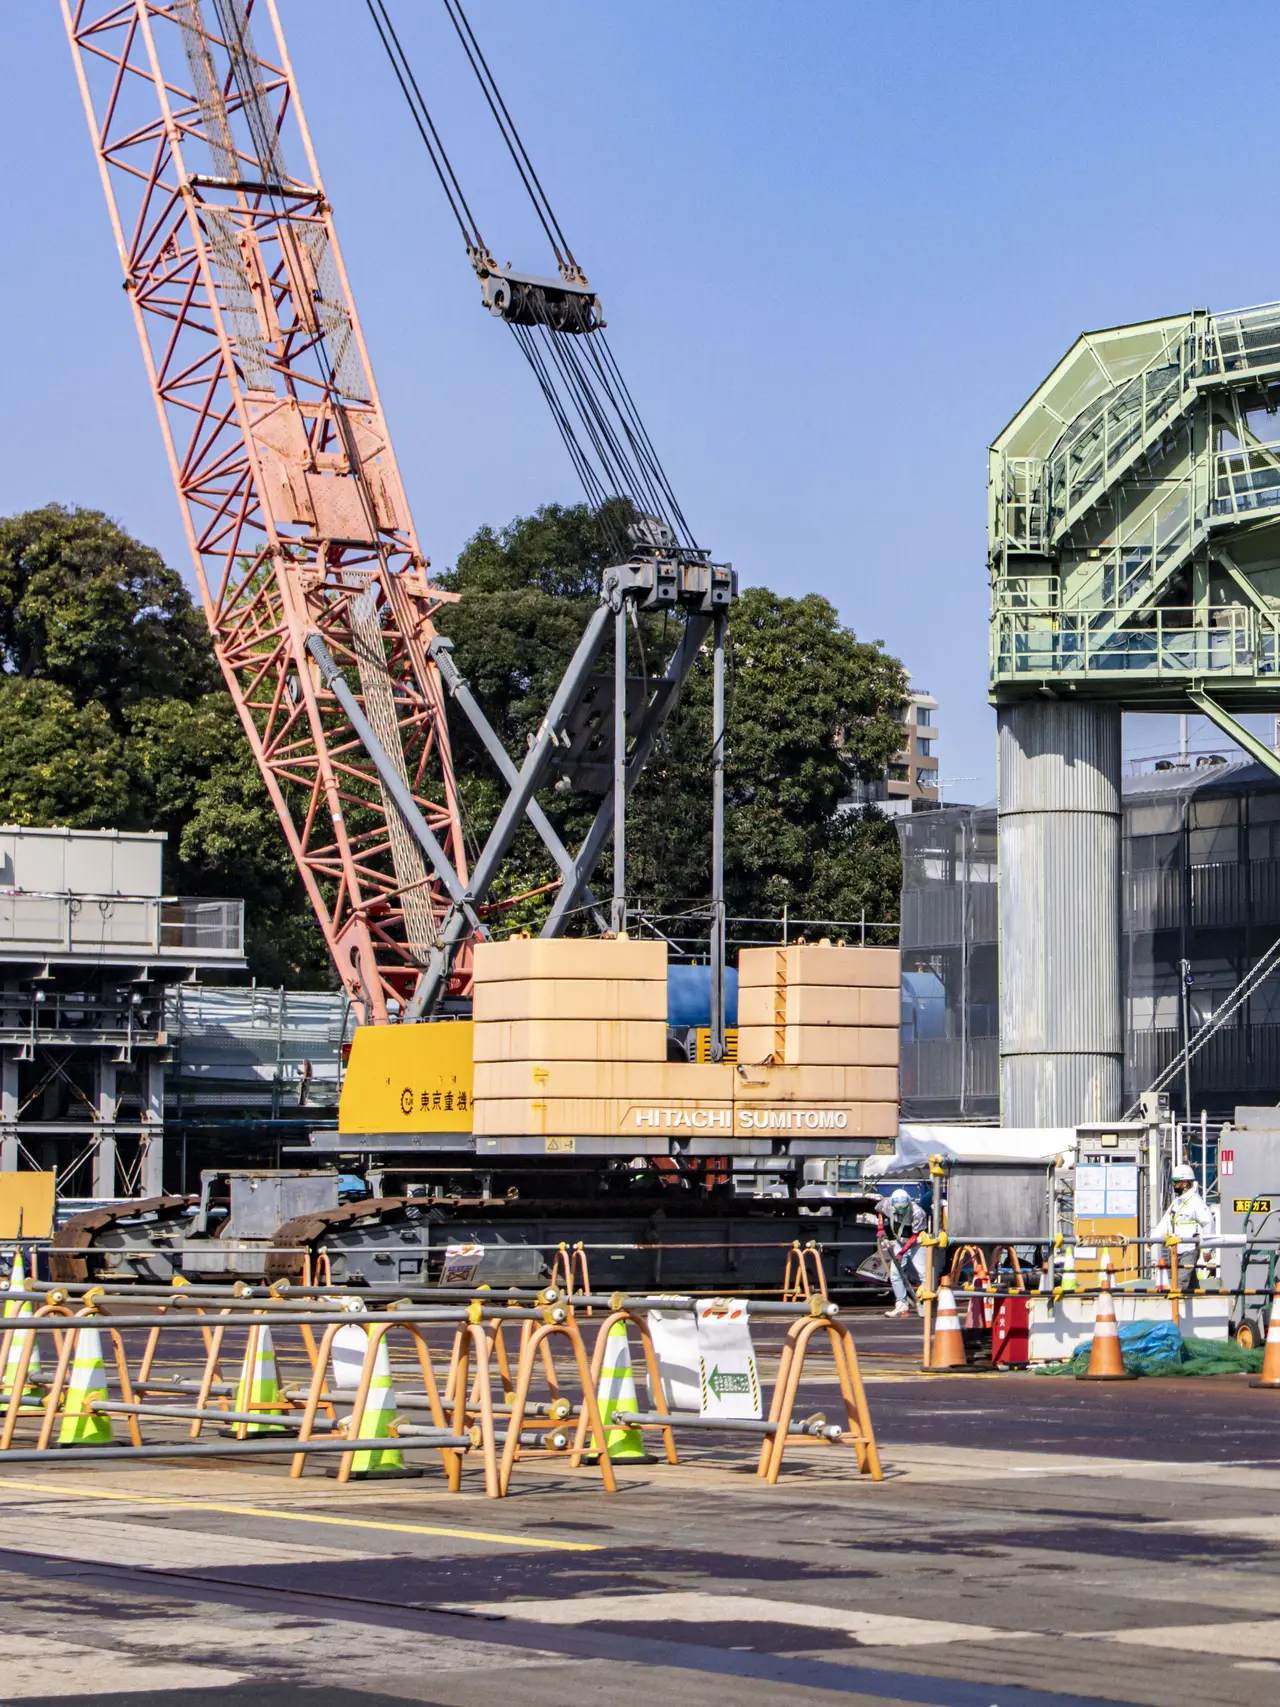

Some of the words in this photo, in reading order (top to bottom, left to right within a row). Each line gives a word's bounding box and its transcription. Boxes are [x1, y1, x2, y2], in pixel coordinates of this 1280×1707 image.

[635, 1110, 732, 1128] HITACHI
[738, 1110, 848, 1129] SUMITOMO
[1236, 1200, 1269, 1212] 高圧ガス
